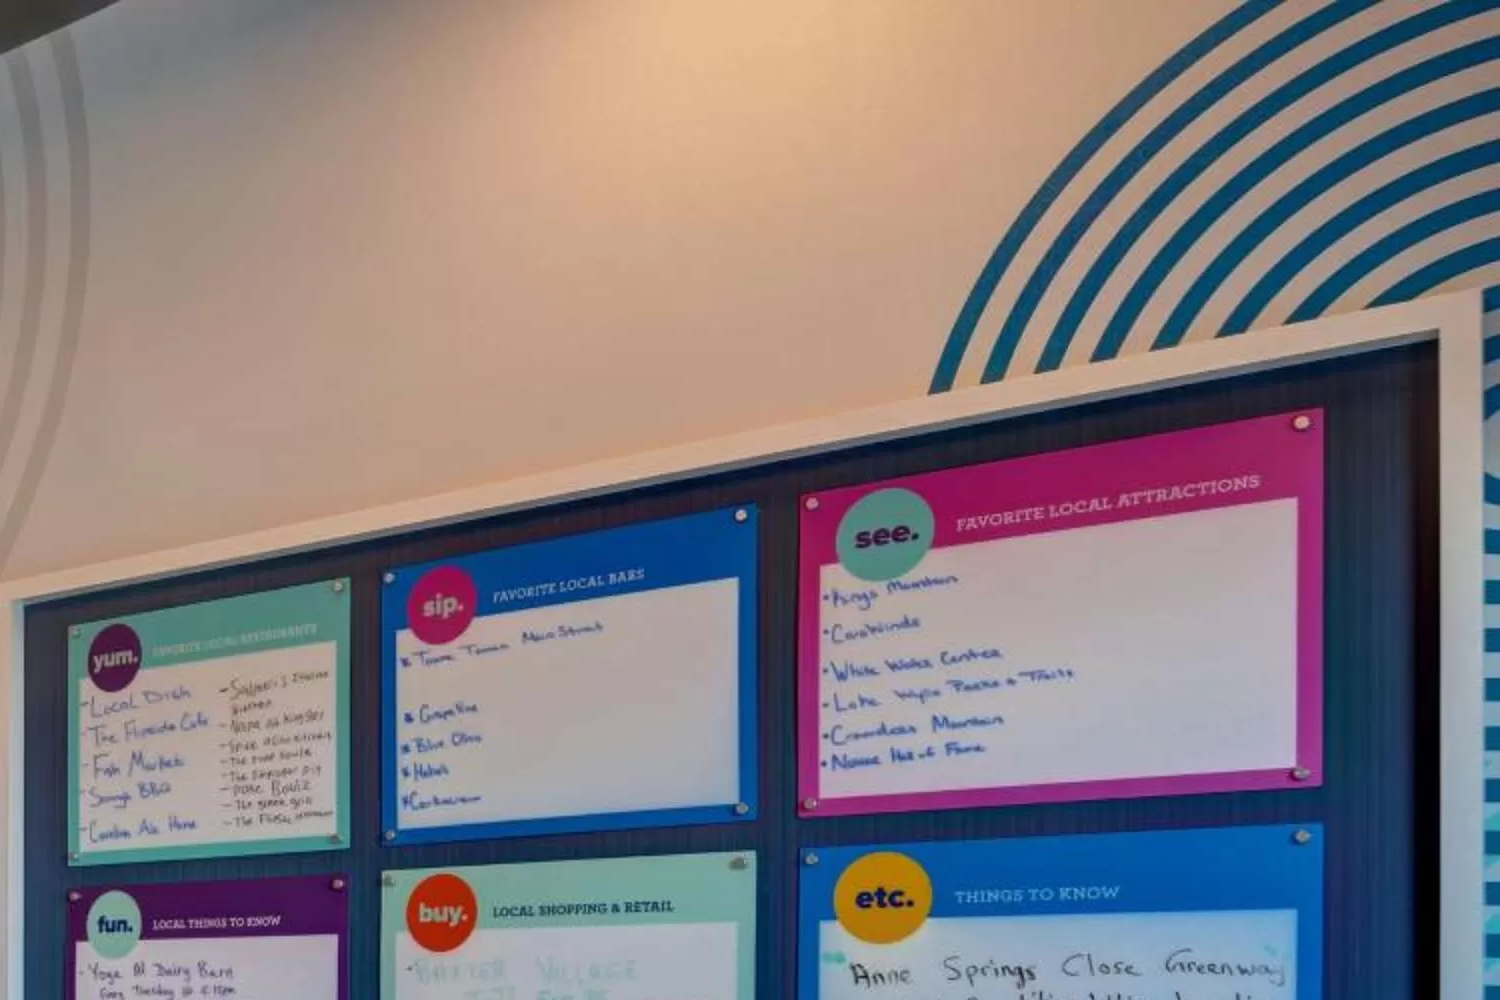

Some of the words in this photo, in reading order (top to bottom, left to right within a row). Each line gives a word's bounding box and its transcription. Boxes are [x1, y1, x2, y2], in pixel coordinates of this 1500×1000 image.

[956, 507, 1045, 532] FAVORITE
[1049, 497, 1113, 518] LOCAL
[1118, 474, 1262, 509] ATTRACTIONS
[855, 521, 920, 549] see.
[493, 581, 557, 604] FAVORITE
[559, 575, 605, 593] LOCAL
[608, 568, 645, 585] BARS
[422, 593, 464, 620] sip.
[92, 648, 139, 673] yum.
[855, 884, 915, 909] etc.
[955, 888, 1024, 905] THINGS
[1028, 887, 1054, 903] TO
[1060, 884, 1120, 901] KNOW
[418, 902, 468, 926] buy.
[492, 904, 535, 919] LOCAL
[538, 903, 608, 917] SHOPPING
[610, 902, 621, 915] &
[624, 900, 675, 914] RETAIL
[96, 914, 133, 934] fun.
[152, 918, 186, 931] LOCAL
[187, 917, 228, 930] THINGS
[230, 916, 245, 929] TO
[247, 914, 282, 928] KNOW
[850, 962, 913, 989] Anne
[943, 955, 1037, 989] Springs
[1061, 952, 1142, 977] Close
[1165, 947, 1286, 987] Greenway
